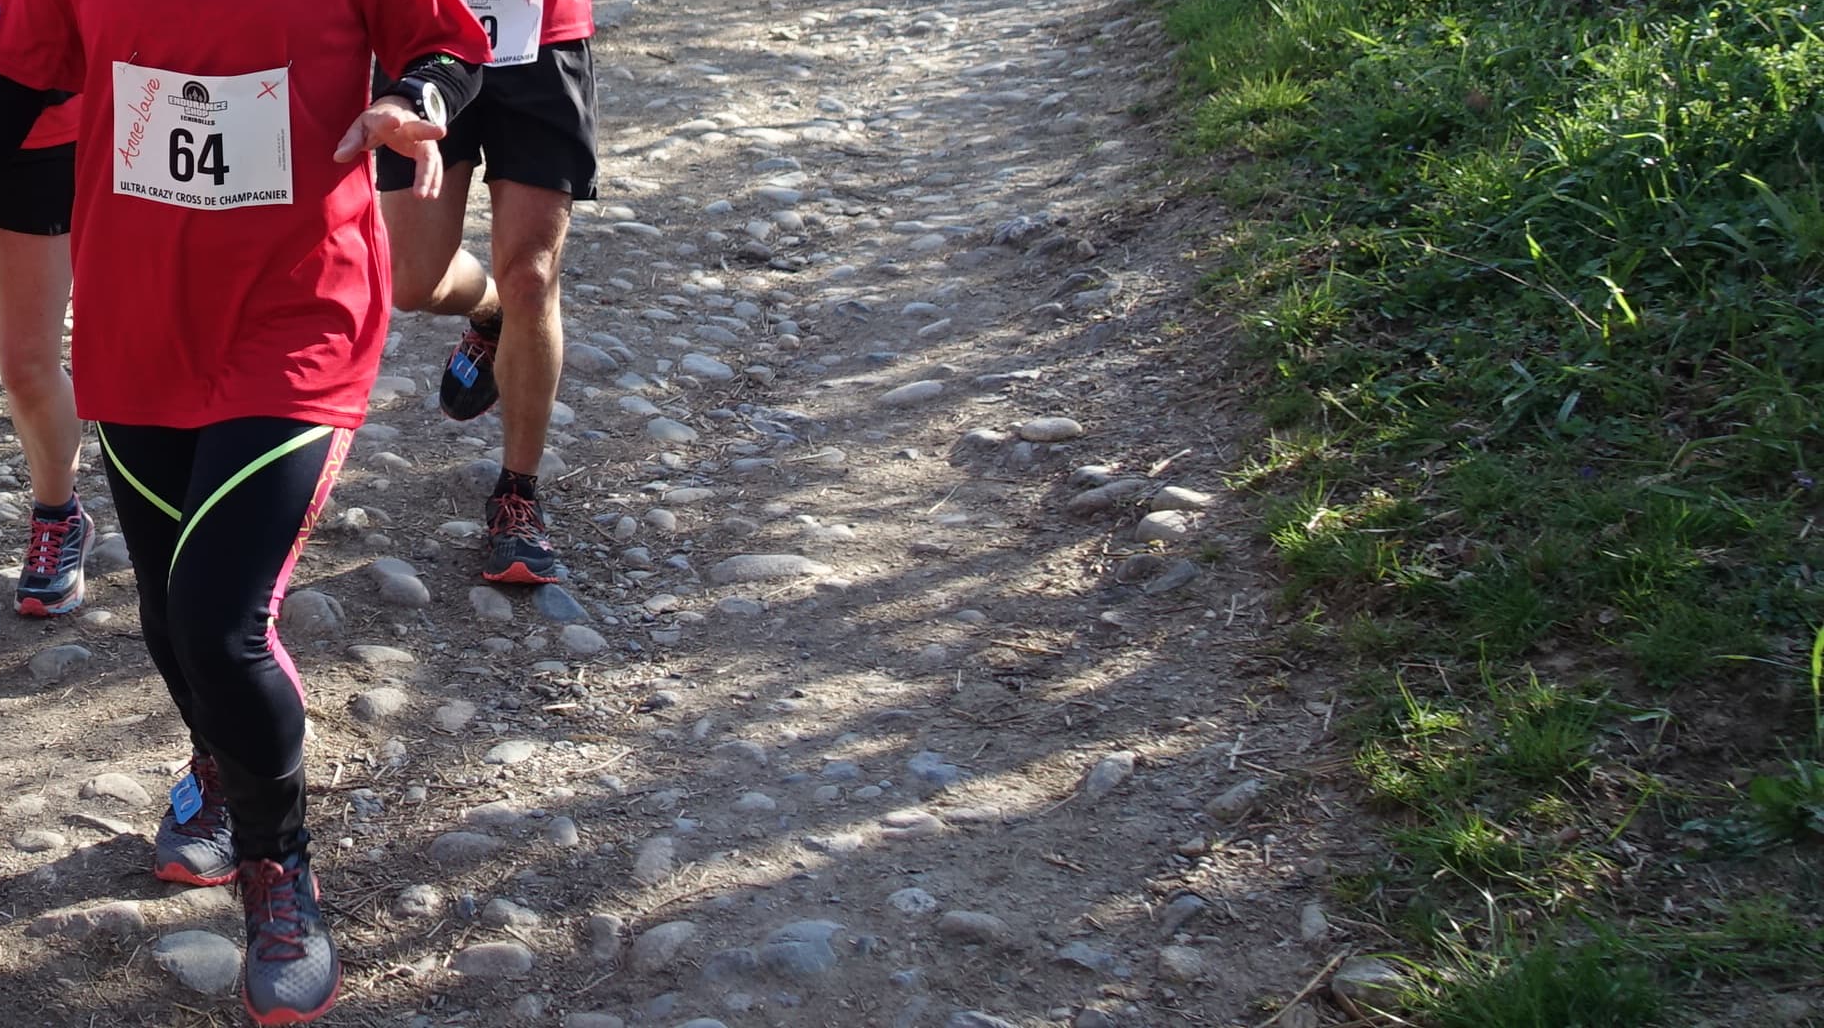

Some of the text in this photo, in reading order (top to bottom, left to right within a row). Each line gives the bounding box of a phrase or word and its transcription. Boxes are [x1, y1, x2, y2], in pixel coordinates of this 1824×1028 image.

[168, 95, 228, 111] ENDURANCE
[180, 115, 216, 126] ECHIROLLES
[184, 107, 210, 118] SHOP
[168, 128, 230, 186] 64
[120, 181, 288, 206] ULTRA CRAZY CROSS DE CHAMPAGNIER
